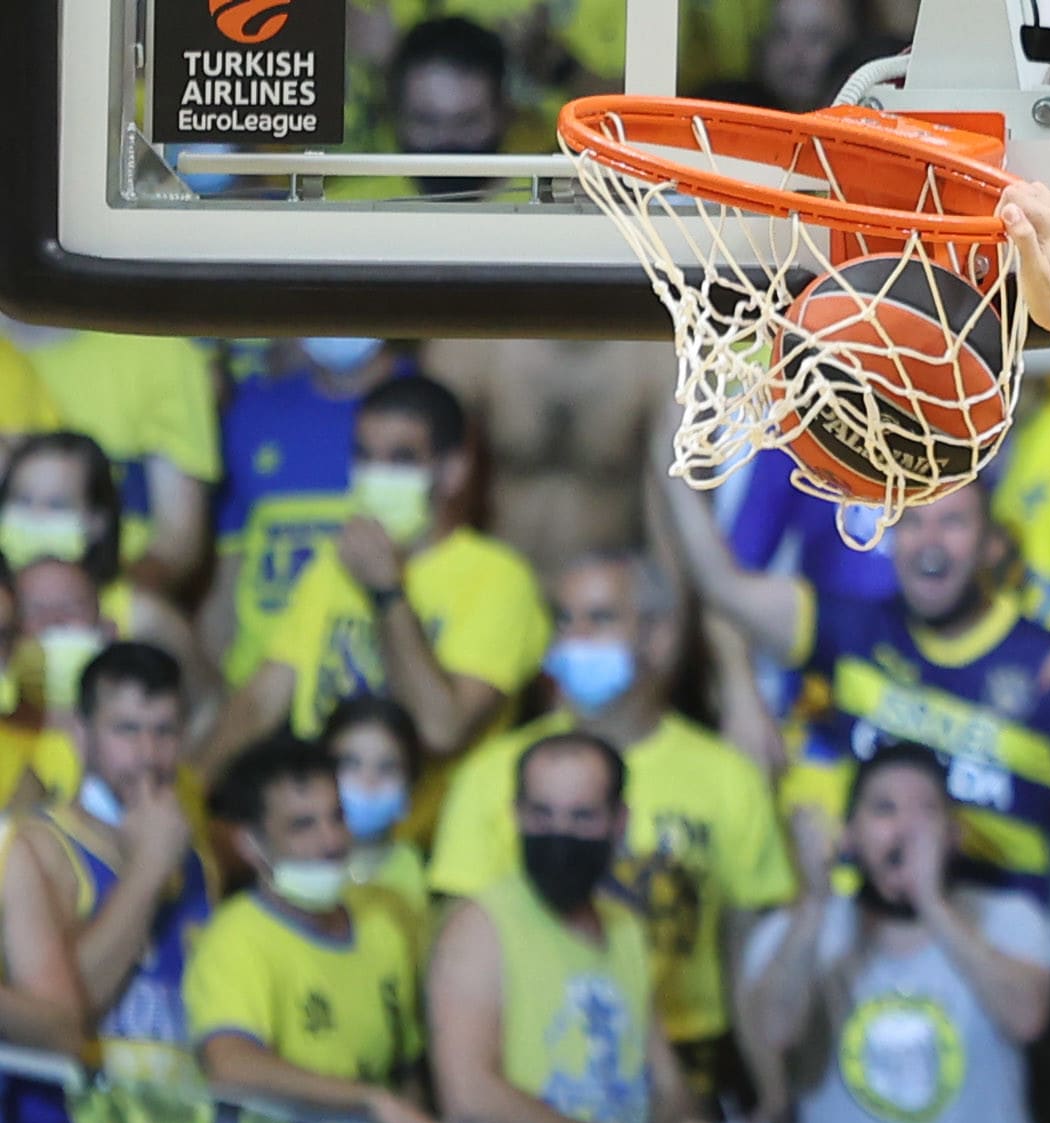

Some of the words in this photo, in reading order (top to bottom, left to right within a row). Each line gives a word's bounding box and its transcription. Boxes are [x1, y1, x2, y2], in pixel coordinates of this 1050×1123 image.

[183, 51, 315, 77] TURKISH
[181, 80, 316, 106] AIRLINES
[178, 109, 317, 138] EuroLeague
